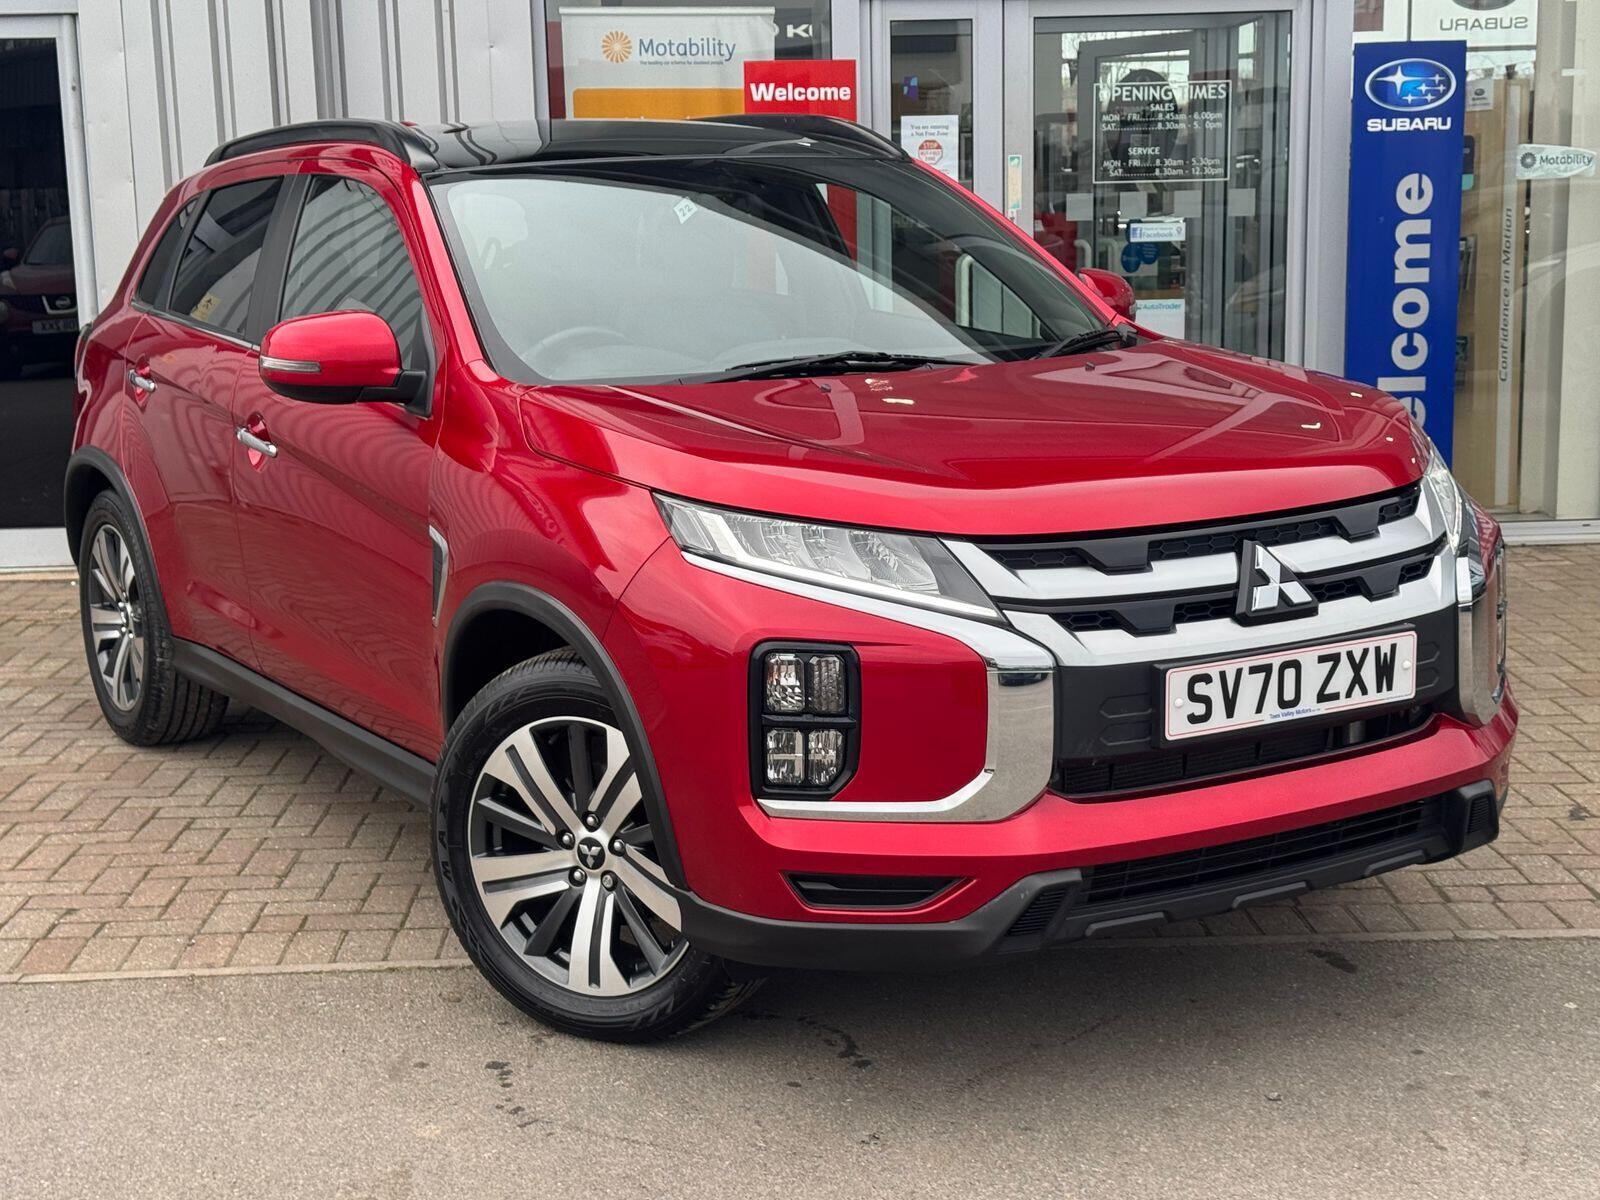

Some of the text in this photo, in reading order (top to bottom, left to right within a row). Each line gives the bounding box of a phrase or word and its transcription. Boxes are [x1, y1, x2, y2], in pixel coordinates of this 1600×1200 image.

[639, 37, 735, 61] Motability
[750, 83, 851, 101] Welcome
[1179, 84, 1227, 99] IMES
[1150, 103, 1175, 111] SALES
[1102, 113, 1120, 121] MON
[1366, 117, 1452, 132] SUBARU
[1128, 147, 1160, 155] SERVICE
[1103, 160, 1121, 168] MON
[1539, 154, 1594, 166] Motability
[1377, 173, 1434, 429] elcome
[1499, 207, 1513, 382] Confidence in Motion
[1186, 643, 1397, 725] SV70 ZXW
